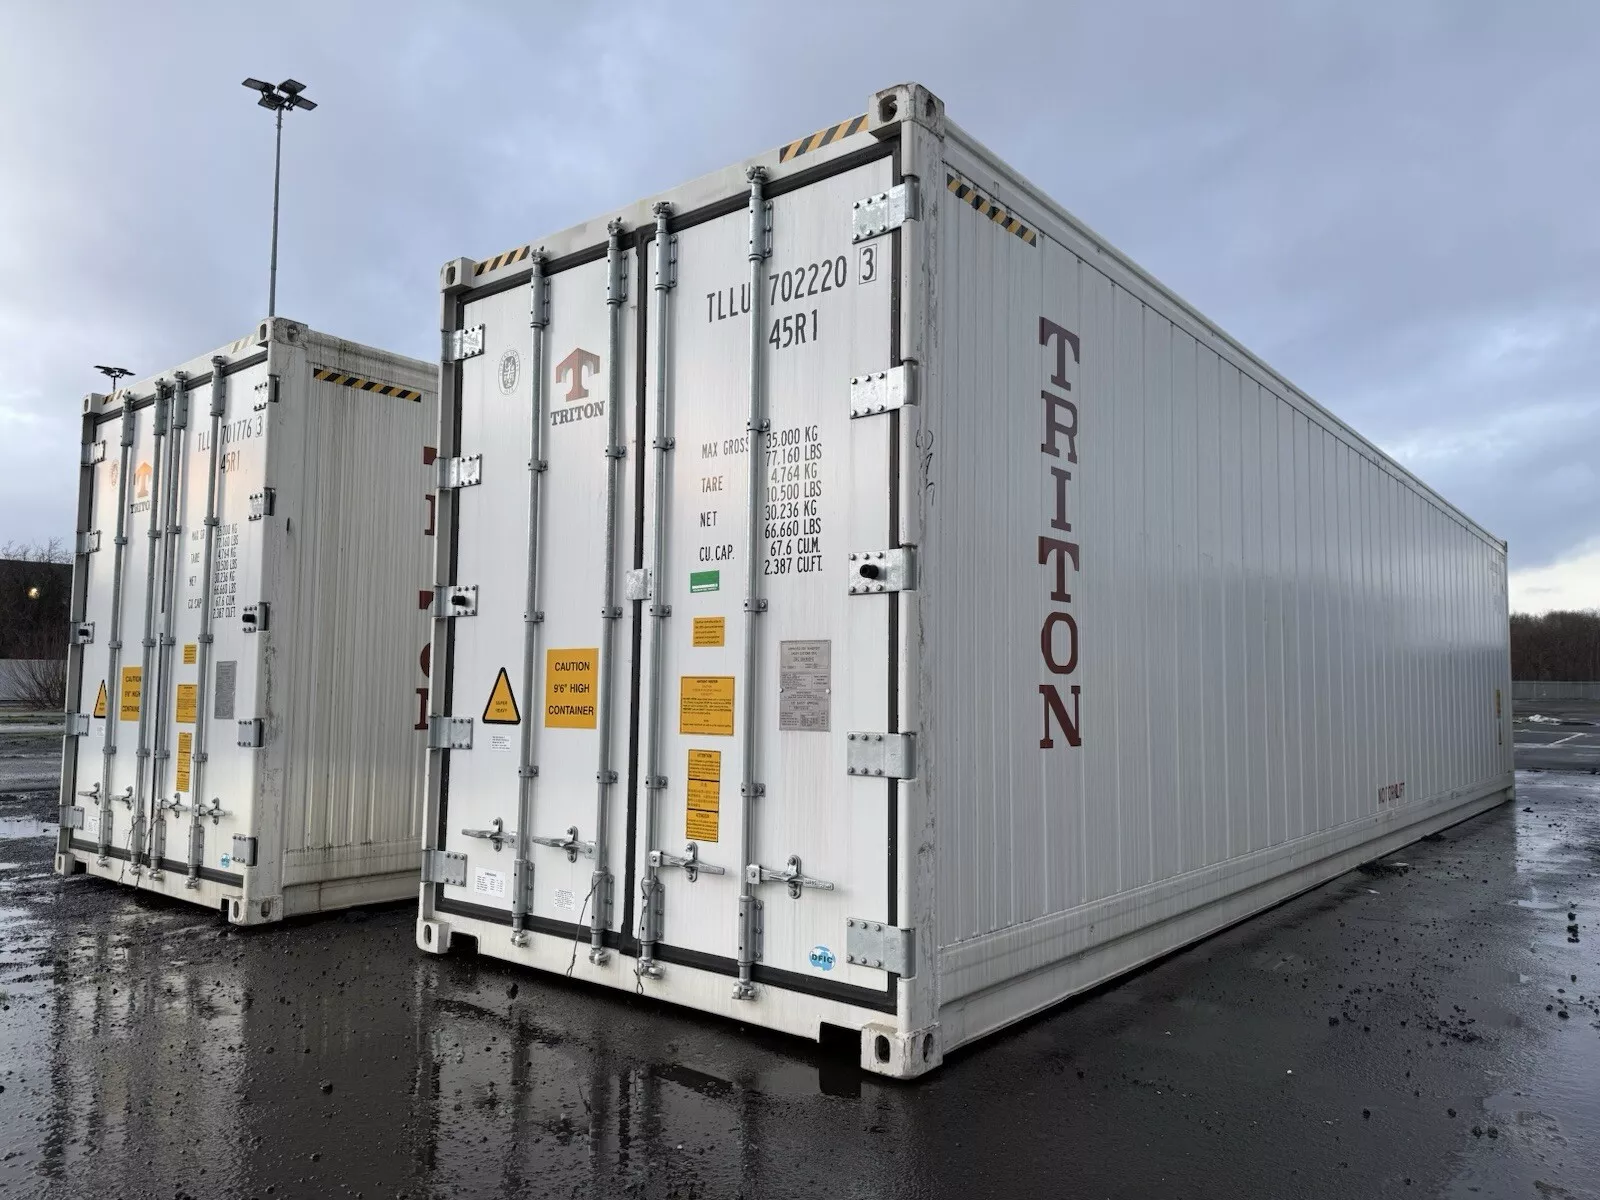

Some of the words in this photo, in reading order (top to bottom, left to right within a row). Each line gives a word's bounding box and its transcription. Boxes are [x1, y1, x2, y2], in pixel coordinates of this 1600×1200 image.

[707, 281, 751, 323] TLLU
[768, 255, 848, 306] 702220
[861, 247, 875, 281] 3
[768, 308, 818, 350] 45R1
[550, 400, 605, 426] TRITON
[197, 430, 210, 452] TLL
[222, 418, 252, 445] 701776
[804, 425, 818, 443] KG
[702, 441, 718, 459] MAX
[804, 443, 822, 461] LBS
[804, 462, 817, 480] KG
[702, 475, 723, 493] TARE
[804, 480, 822, 498] LBS
[803, 500, 817, 517] KG
[700, 511, 718, 527] NET
[803, 518, 822, 535] LBS
[1038, 315, 1082, 750] TRITON
[699, 544, 735, 561] CU.CAP.
[770, 540, 792, 556] 67.6
[554, 662, 590, 671] CAUTION
[569, 684, 590, 693] HIGH
[548, 705, 594, 716] CONTAINER
[811, 953, 833, 964] DFIC
